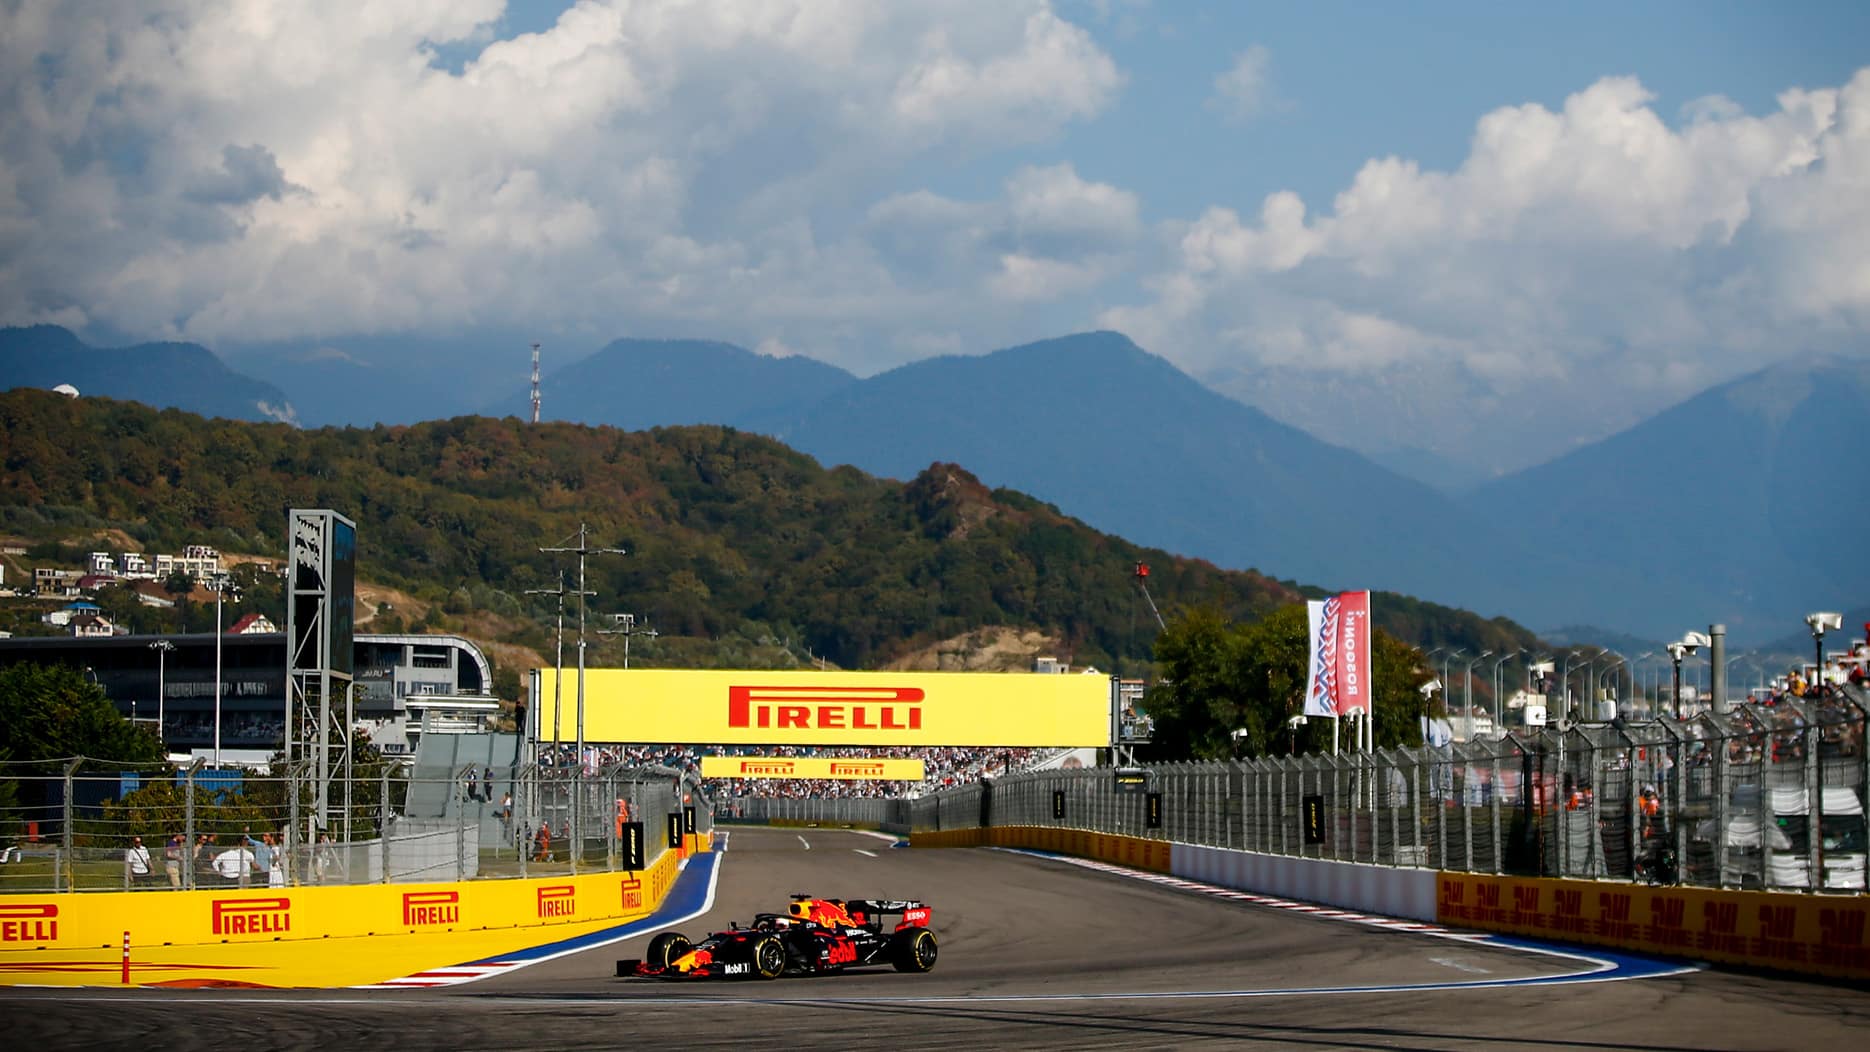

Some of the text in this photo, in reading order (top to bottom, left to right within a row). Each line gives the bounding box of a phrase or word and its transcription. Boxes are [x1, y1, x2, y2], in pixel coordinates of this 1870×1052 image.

[729, 686, 925, 729] PIRELLI
[740, 762, 795, 775] PIRELLI
[830, 763, 885, 776] PIRELLI
[403, 892, 459, 926] PIRELLI
[538, 885, 575, 918] PIRELLI
[621, 879, 642, 909] PIRELLI
[212, 898, 290, 935] PIRELLI
[724, 963, 742, 975] Mobil
